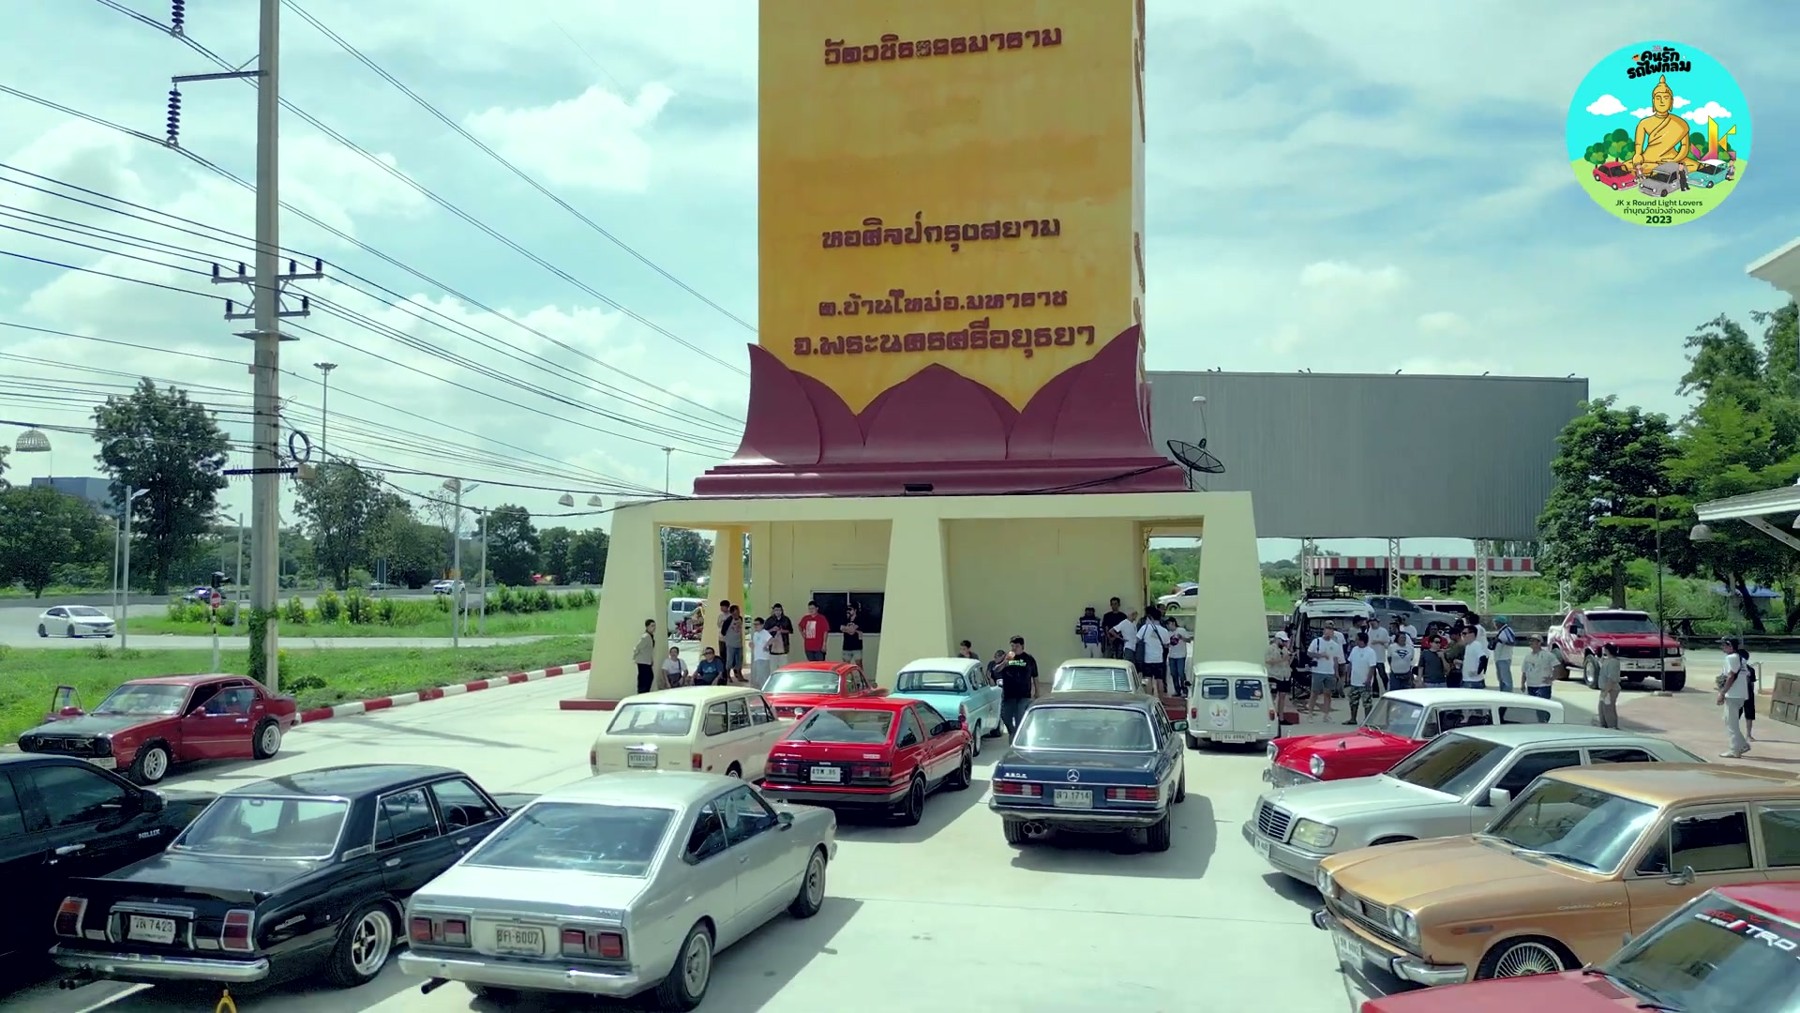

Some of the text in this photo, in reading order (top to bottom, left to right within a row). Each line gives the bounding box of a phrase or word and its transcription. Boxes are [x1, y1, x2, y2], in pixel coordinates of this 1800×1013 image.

[822, 210, 1061, 252] หอศิลป์กรุงสยาม
[149, 919, 173, 933] 7423
